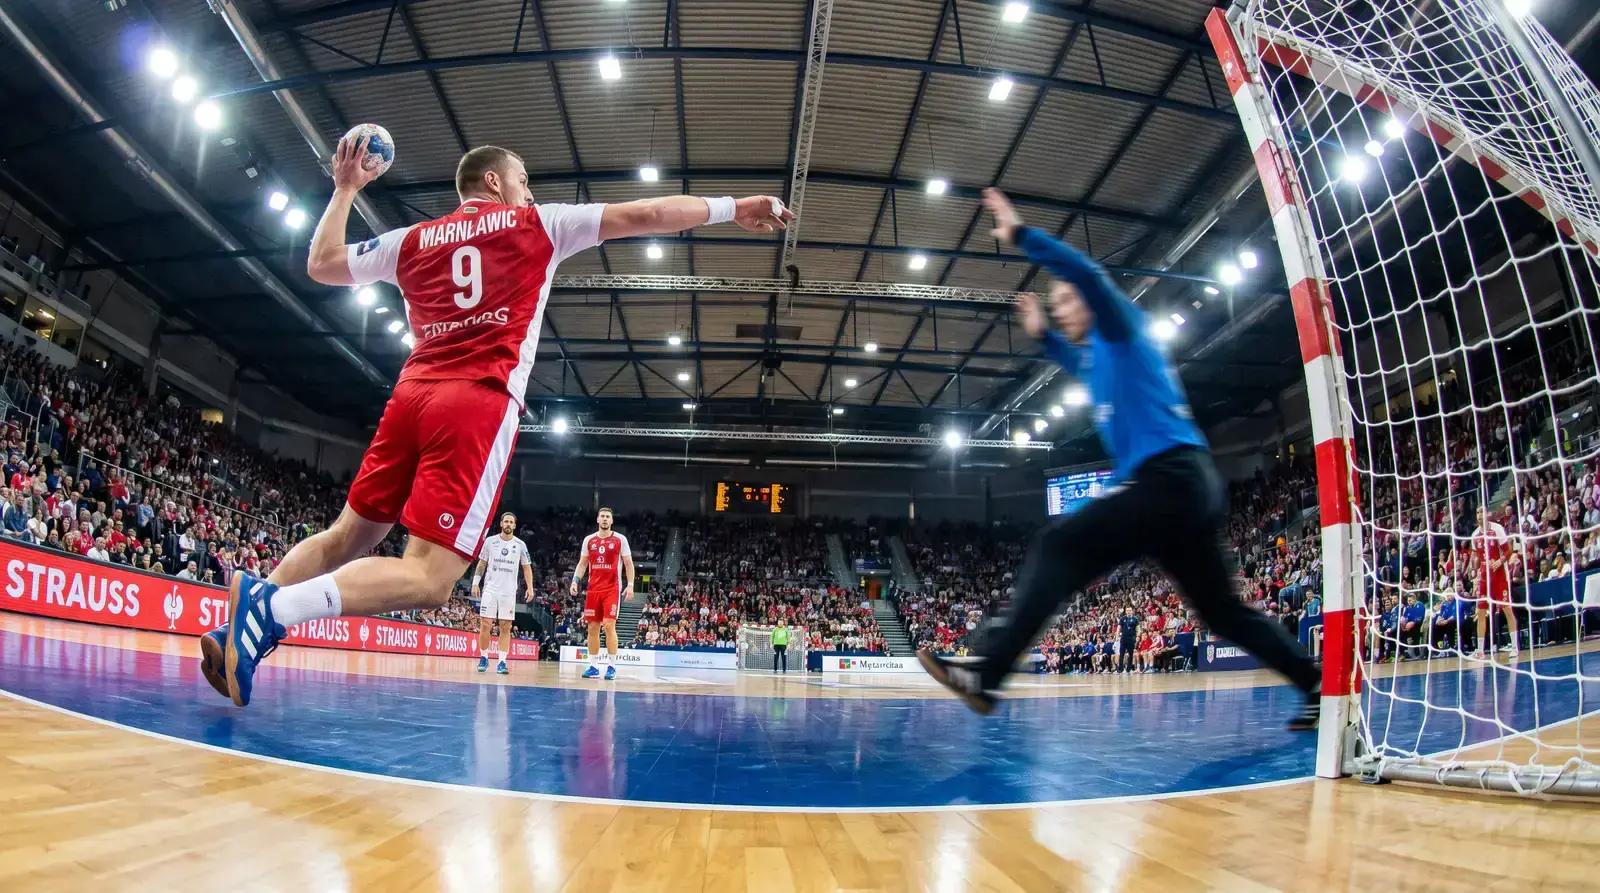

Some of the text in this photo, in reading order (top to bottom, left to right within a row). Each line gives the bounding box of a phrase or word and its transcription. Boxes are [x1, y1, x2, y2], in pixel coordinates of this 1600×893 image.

[452, 245, 483, 309] 9
[5, 559, 140, 617] STRAUSS
[376, 625, 418, 649] STRAUSS
[436, 633, 467, 653] STRAUSS
